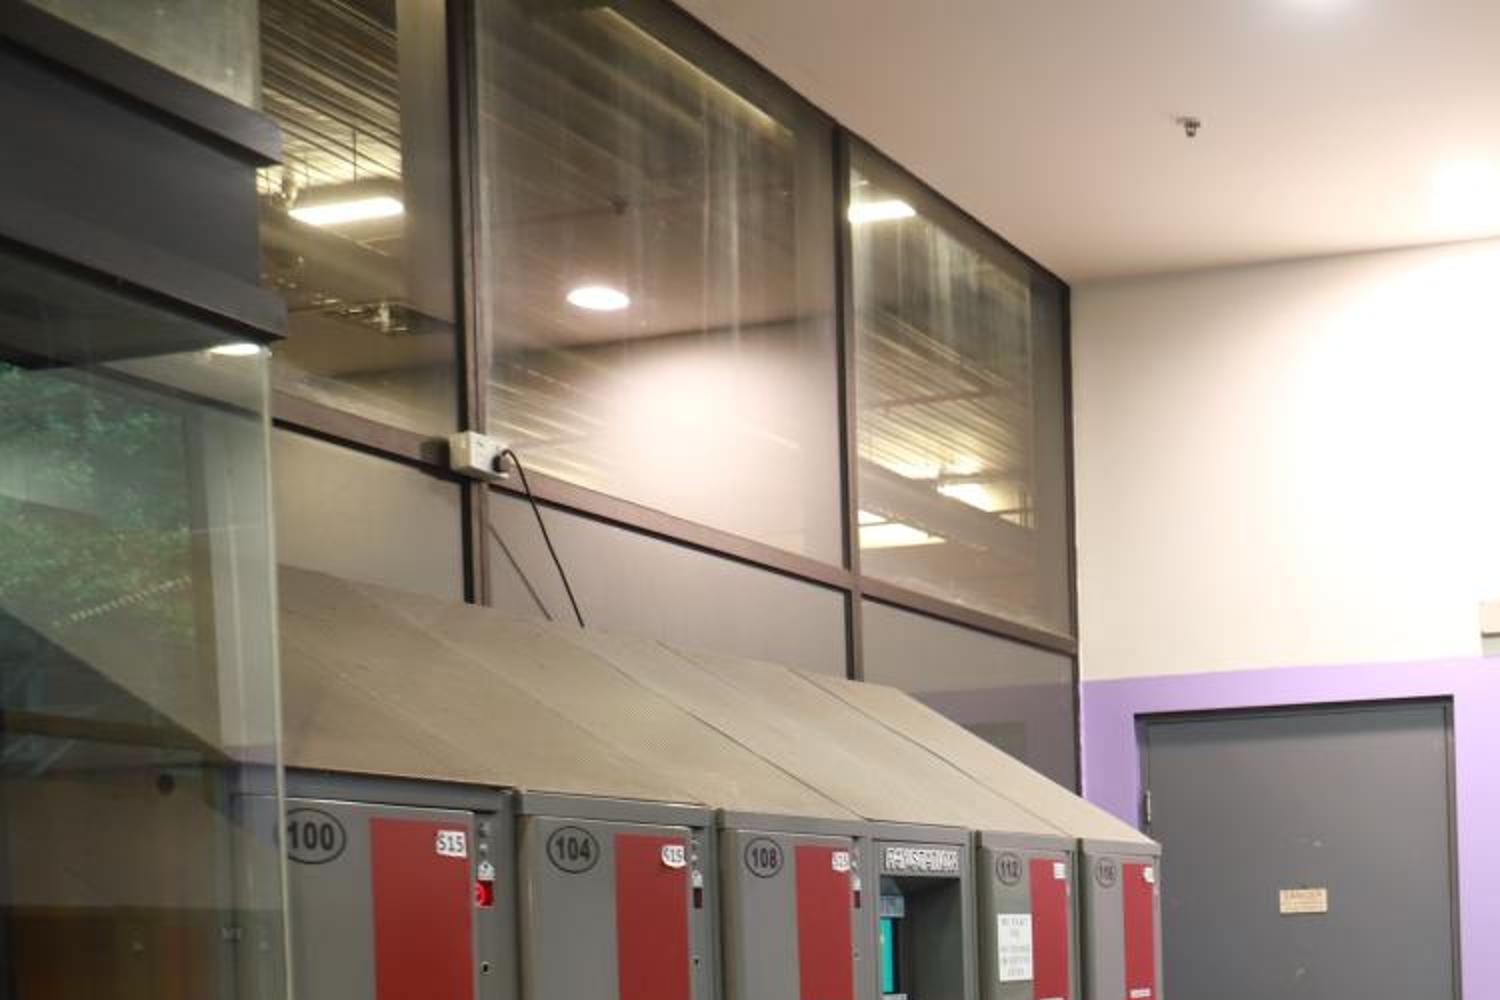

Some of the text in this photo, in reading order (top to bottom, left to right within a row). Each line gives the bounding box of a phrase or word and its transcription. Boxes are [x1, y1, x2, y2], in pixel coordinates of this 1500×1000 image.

[287, 821, 335, 850] 100
[555, 836, 590, 862] 104
[752, 847, 778, 868] 108
